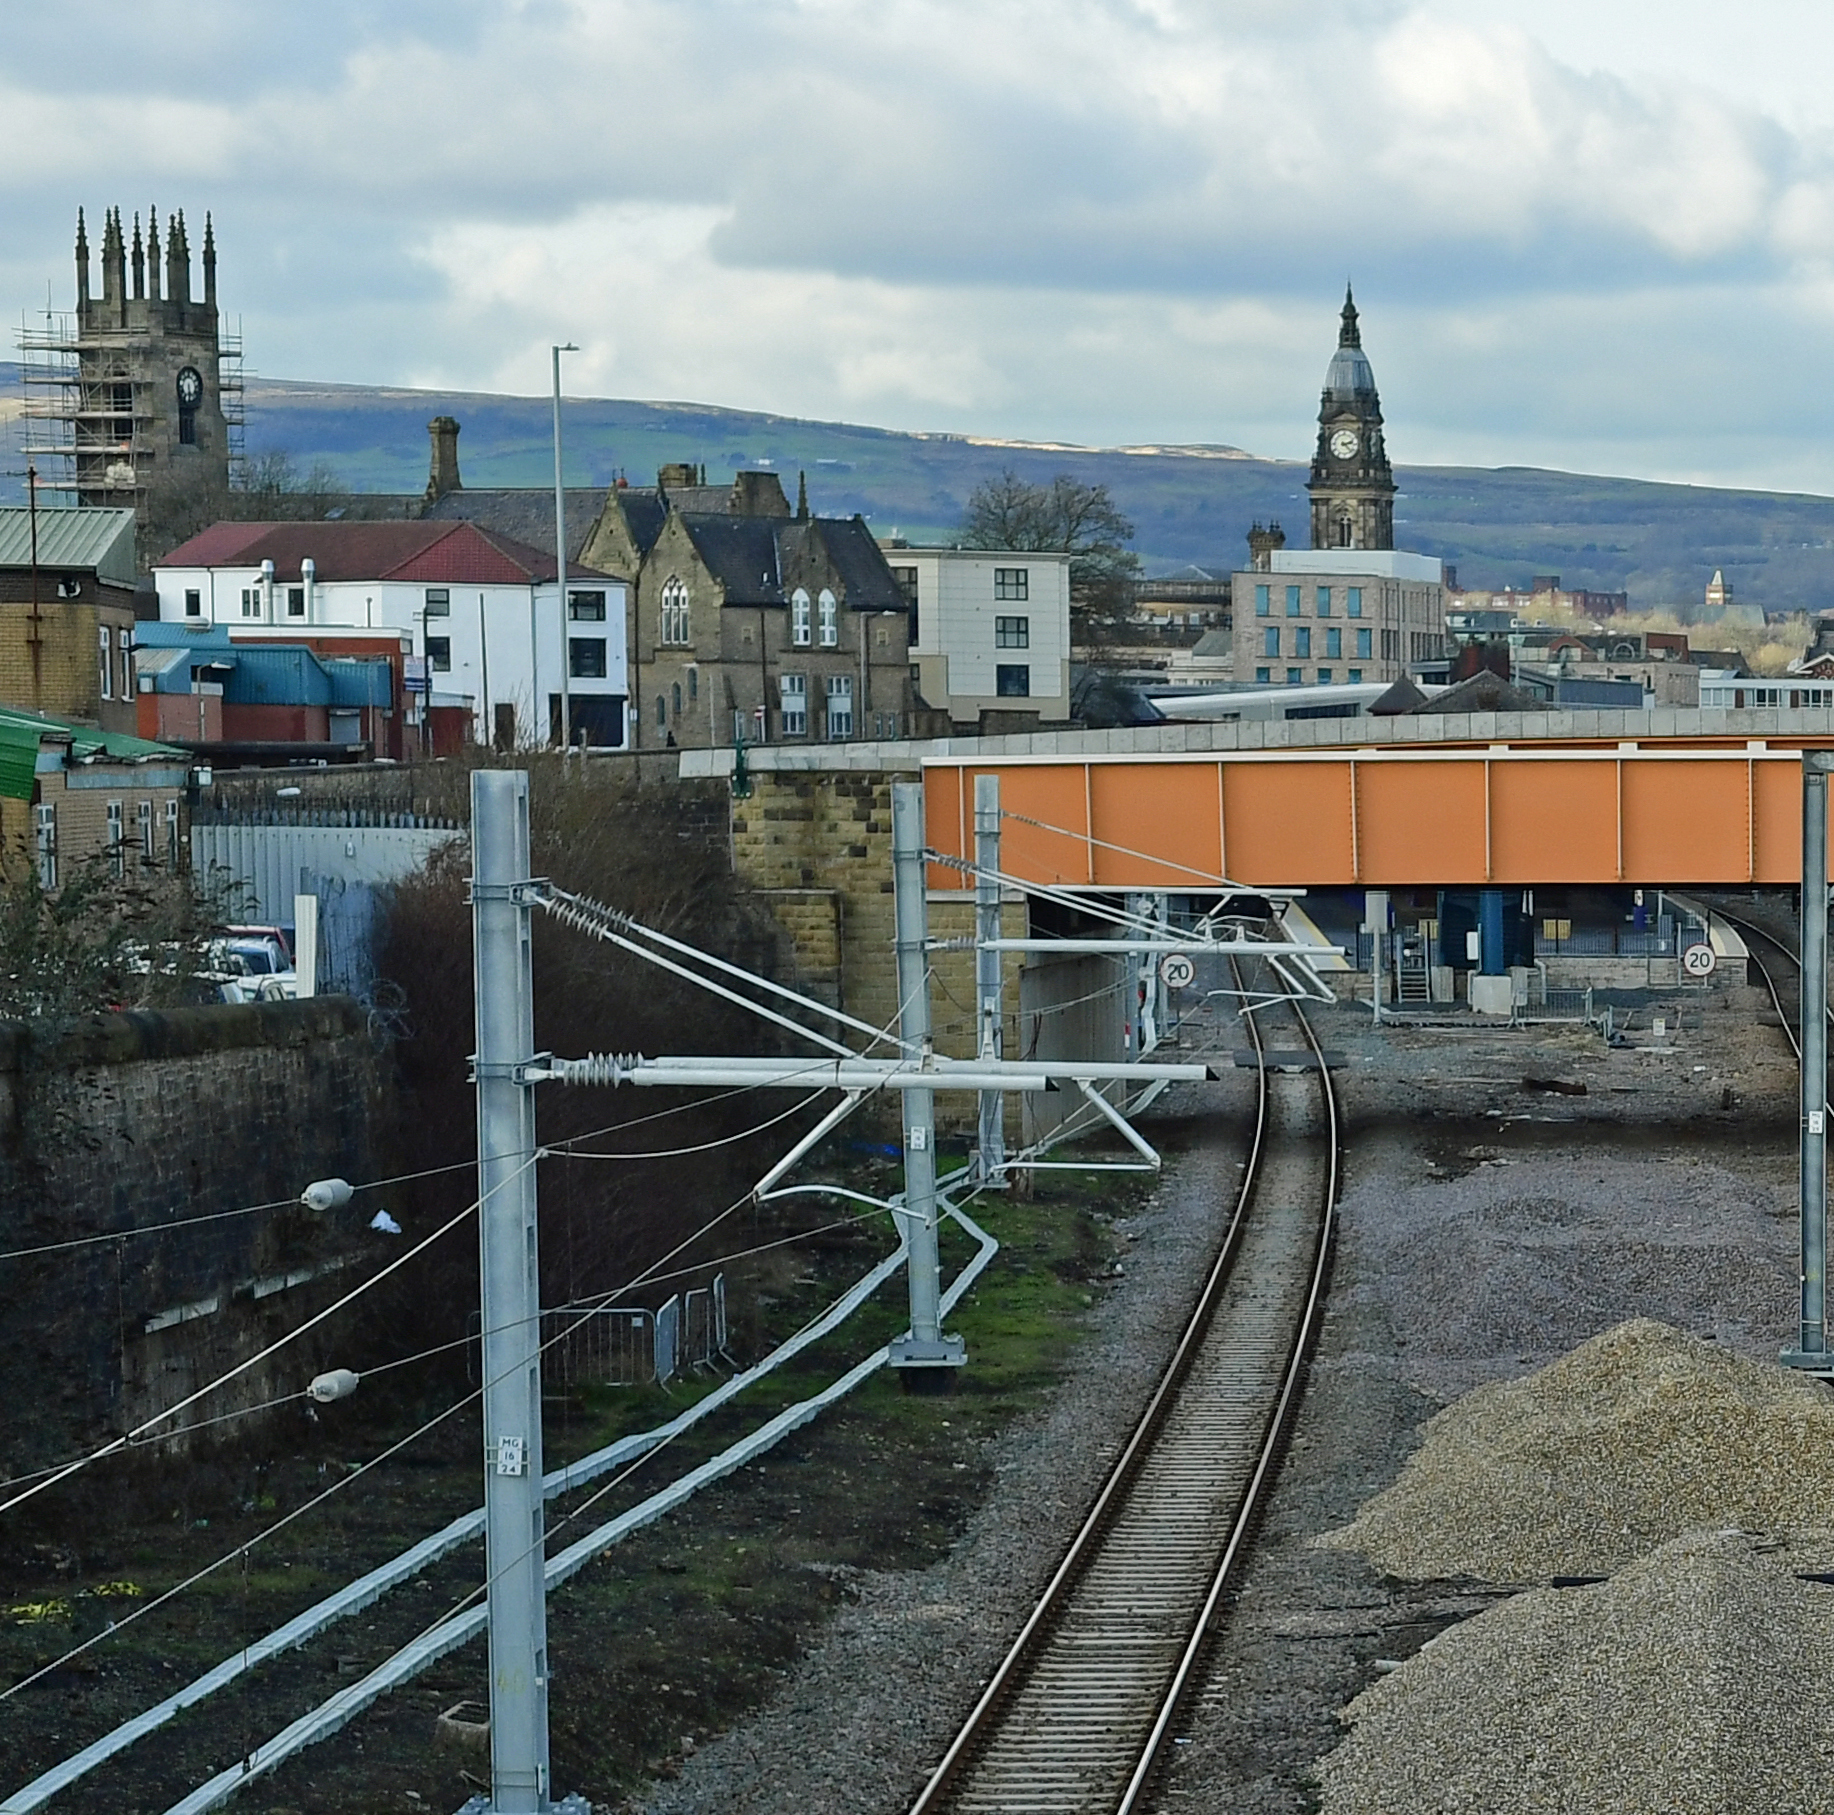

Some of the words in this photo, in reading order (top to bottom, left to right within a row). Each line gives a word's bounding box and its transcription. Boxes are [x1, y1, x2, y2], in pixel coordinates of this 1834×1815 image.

[1690, 952, 1710, 968] 20
[1167, 963, 1190, 980] 20
[502, 1438, 519, 1448] MG
[504, 1451, 515, 1460] 16
[501, 1464, 516, 1473] 24
